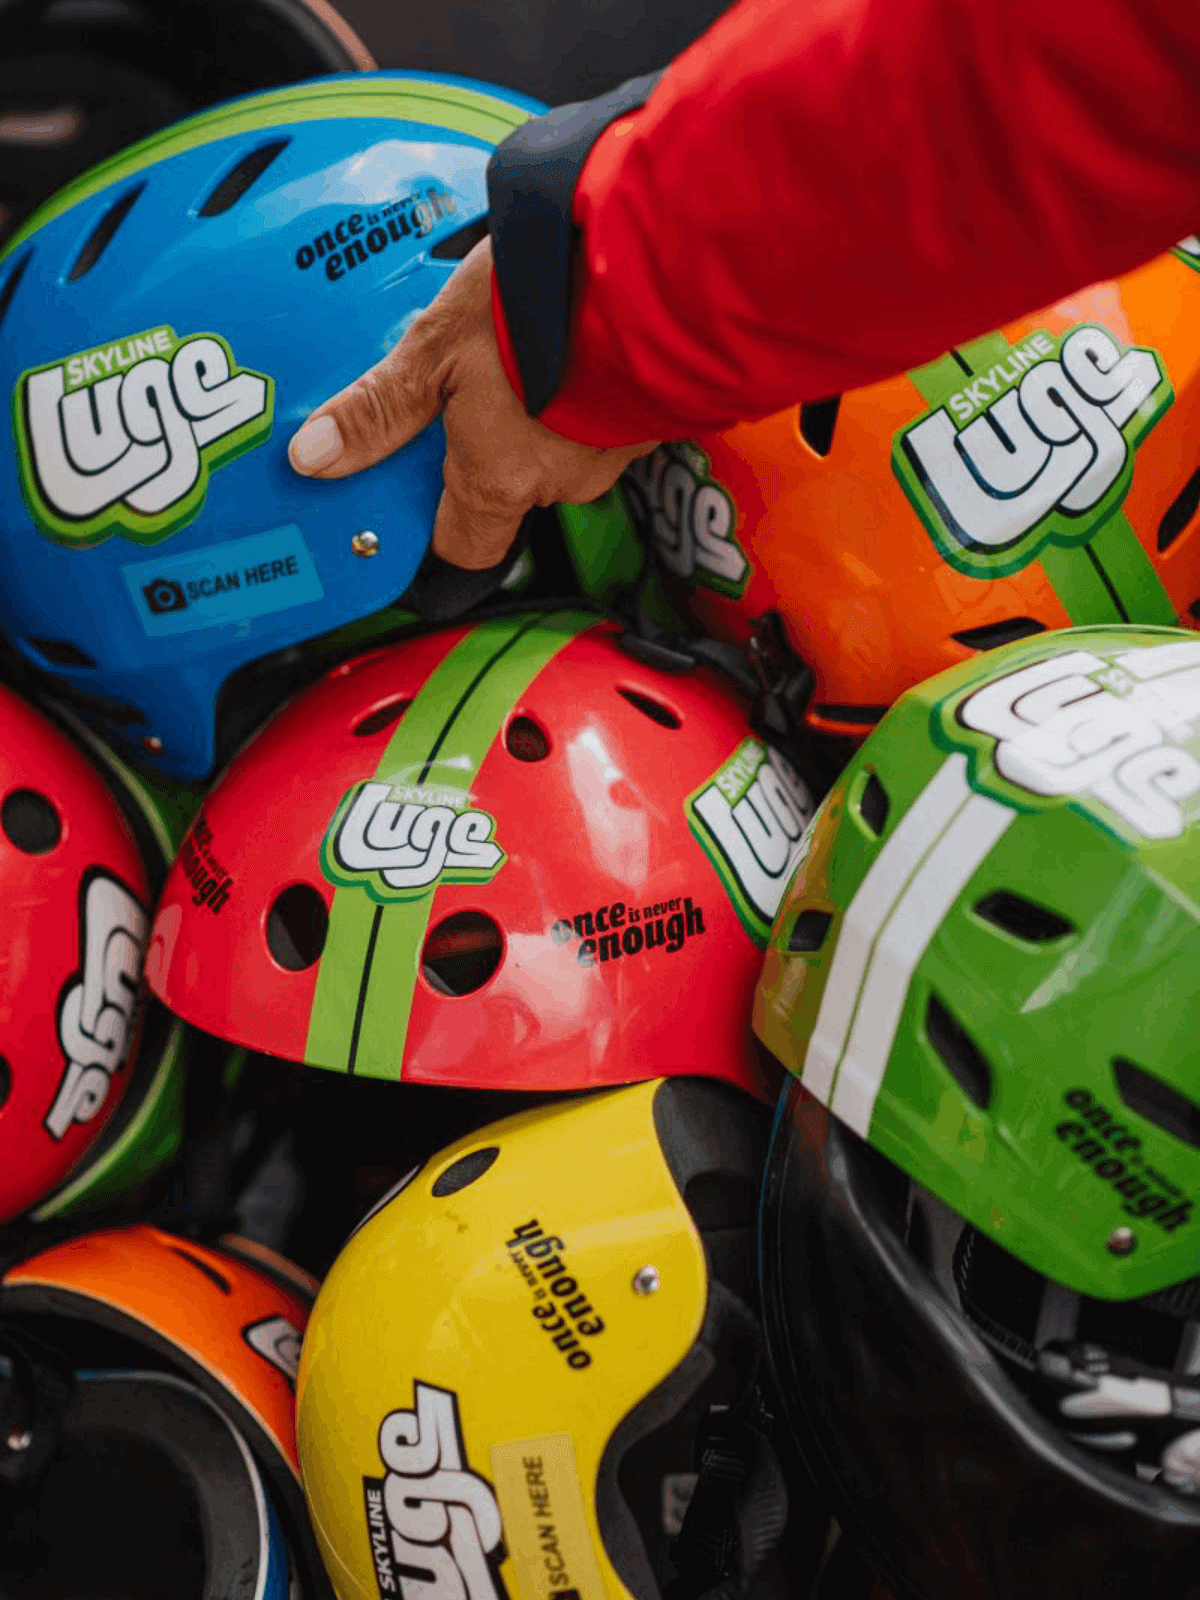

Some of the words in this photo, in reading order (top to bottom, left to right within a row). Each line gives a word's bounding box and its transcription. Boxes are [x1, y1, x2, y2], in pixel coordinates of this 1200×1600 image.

[296, 213, 364, 270] once
[325, 186, 457, 282] enough
[66, 330, 173, 386] SKYLINE
[949, 334, 1054, 420] SKYLINE
[22, 337, 267, 523] Luge
[901, 326, 1163, 555] Luge
[186, 572, 241, 600] SCAN
[244, 554, 300, 587] HERE
[391, 787, 465, 808] SKYLINE
[333, 782, 505, 890] Luge
[551, 902, 625, 947] once
[628, 907, 641, 923] is
[643, 897, 681, 919] never
[576, 897, 705, 969] enough
[1064, 1087, 1141, 1151] once
[1055, 1121, 1195, 1232] enough
[505, 1218, 605, 1336] enough
[531, 1302, 592, 1370] once
[523, 1455, 552, 1518] HERE
[367, 1488, 397, 1593] SKYLINE
[537, 1524, 569, 1587] SCAN
